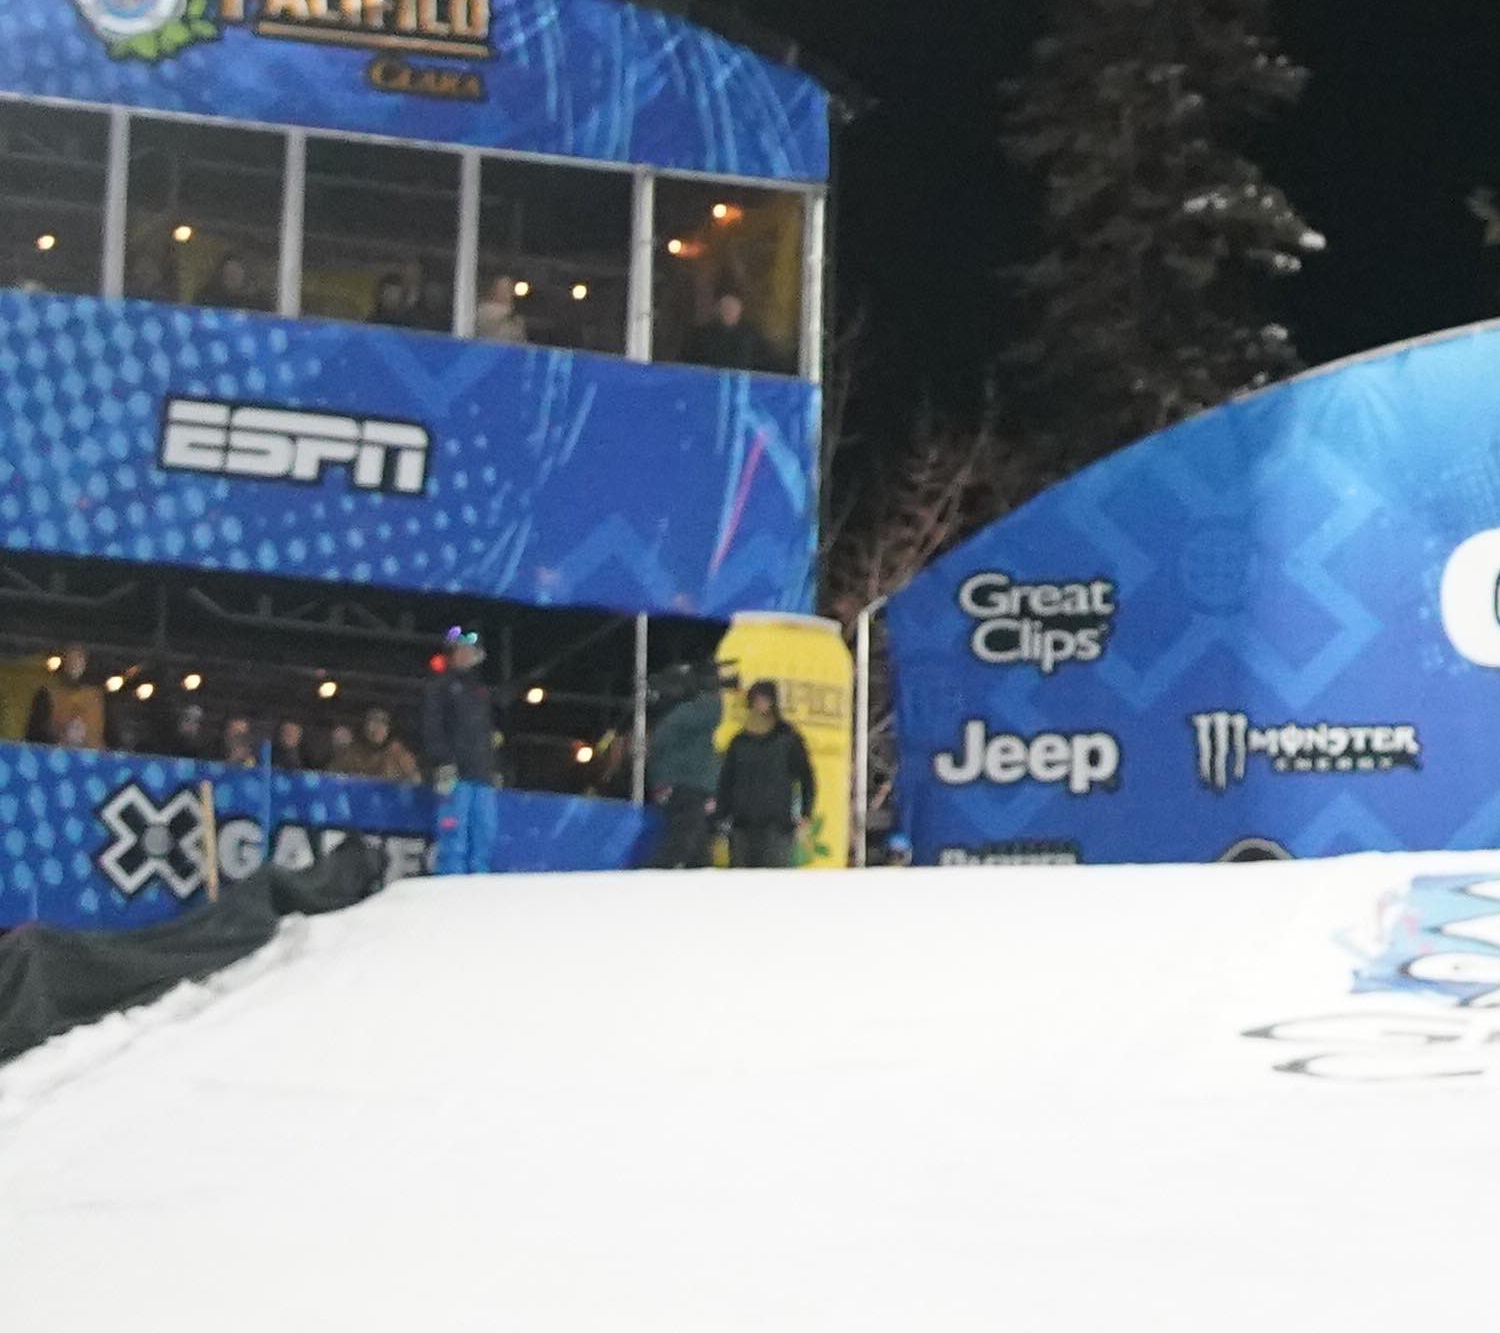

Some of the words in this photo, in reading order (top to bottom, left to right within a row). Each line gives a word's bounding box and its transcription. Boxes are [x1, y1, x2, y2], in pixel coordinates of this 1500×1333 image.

[162, 398, 430, 493] ESPN
[958, 572, 1115, 619] Great
[971, 618, 1104, 673] Clips
[934, 719, 1121, 794] Jeep
[216, 818, 437, 885] GAE
